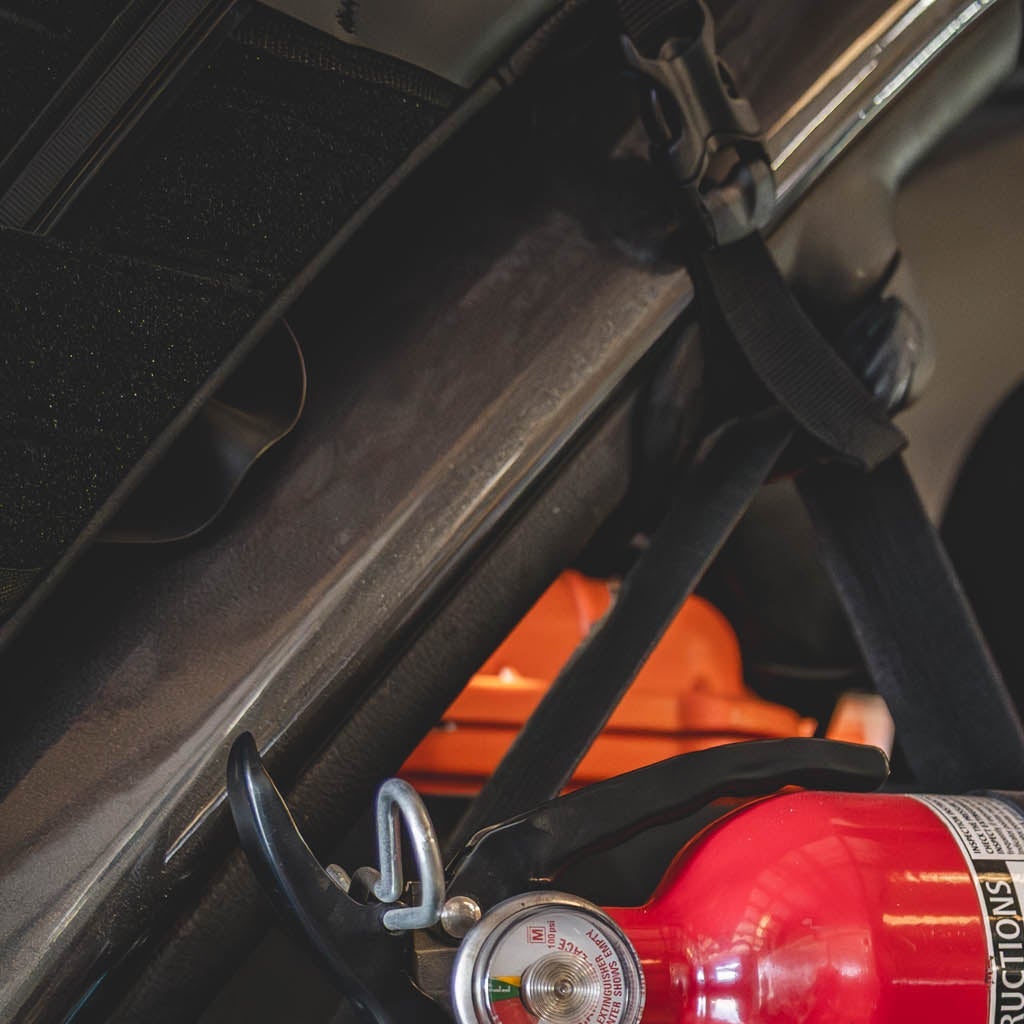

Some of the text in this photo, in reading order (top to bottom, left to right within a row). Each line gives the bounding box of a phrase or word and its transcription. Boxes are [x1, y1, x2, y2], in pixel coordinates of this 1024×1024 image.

[548, 919, 557, 933] psi
[585, 929, 613, 958] EMPTY
[595, 954, 613, 1024] EXTINGUISHER
[608, 961, 622, 997] SHOWS
